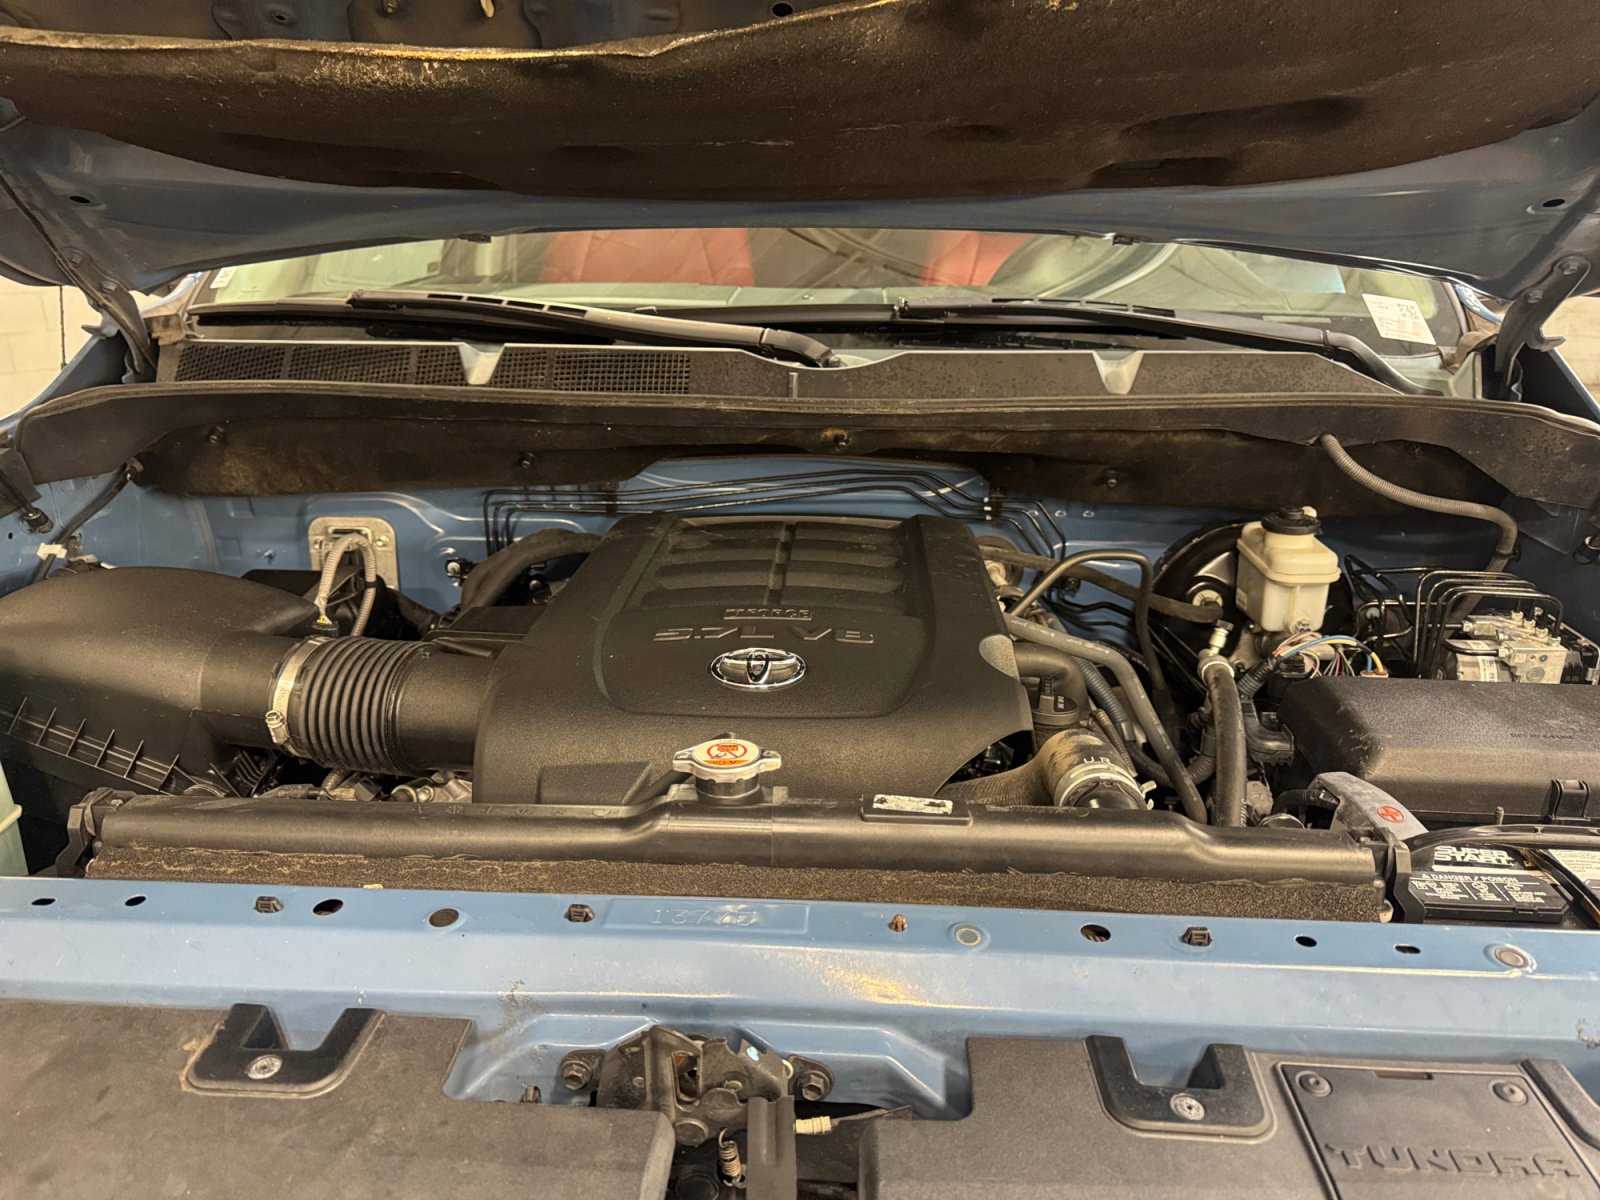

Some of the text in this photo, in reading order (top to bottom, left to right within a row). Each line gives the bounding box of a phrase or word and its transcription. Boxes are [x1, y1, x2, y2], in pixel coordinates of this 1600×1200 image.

[792, 626, 874, 644] V8
[1433, 852, 1516, 867] START
[1434, 845, 1514, 860] SUPER
[1431, 873, 1472, 882] DANGER
[1480, 875, 1519, 884] POISON
[1324, 1143, 1582, 1178] TUNDRA
